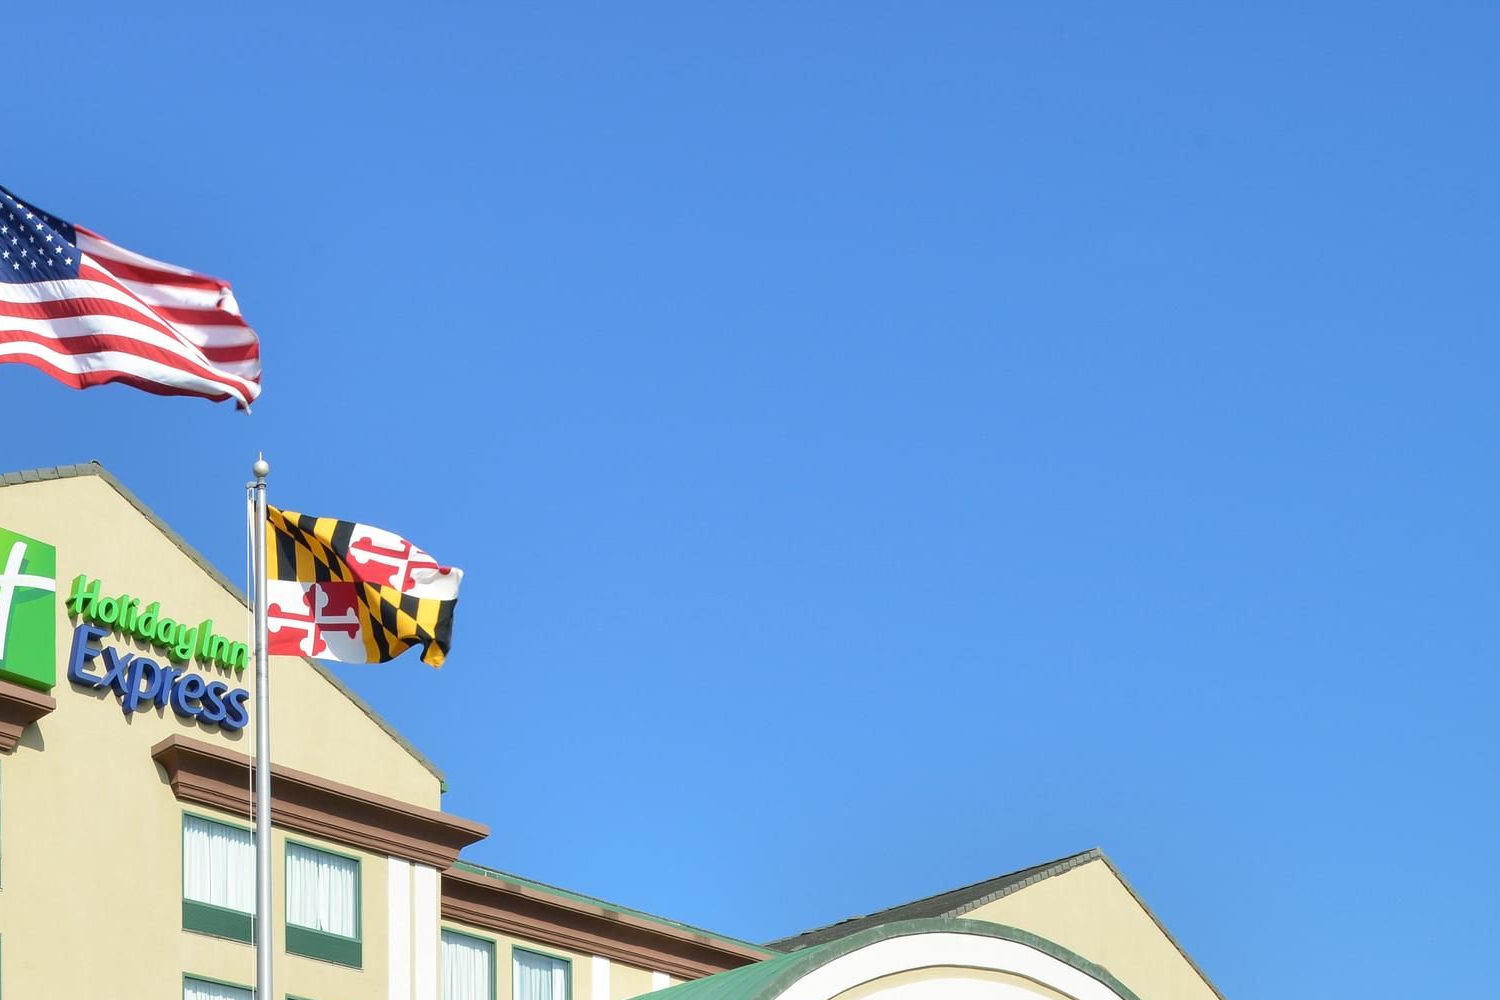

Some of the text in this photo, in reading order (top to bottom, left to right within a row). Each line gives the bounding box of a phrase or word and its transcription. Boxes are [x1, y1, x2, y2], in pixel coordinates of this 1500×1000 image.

[66, 574, 248, 673] Holiday Inn
[67, 623, 250, 731] Express
